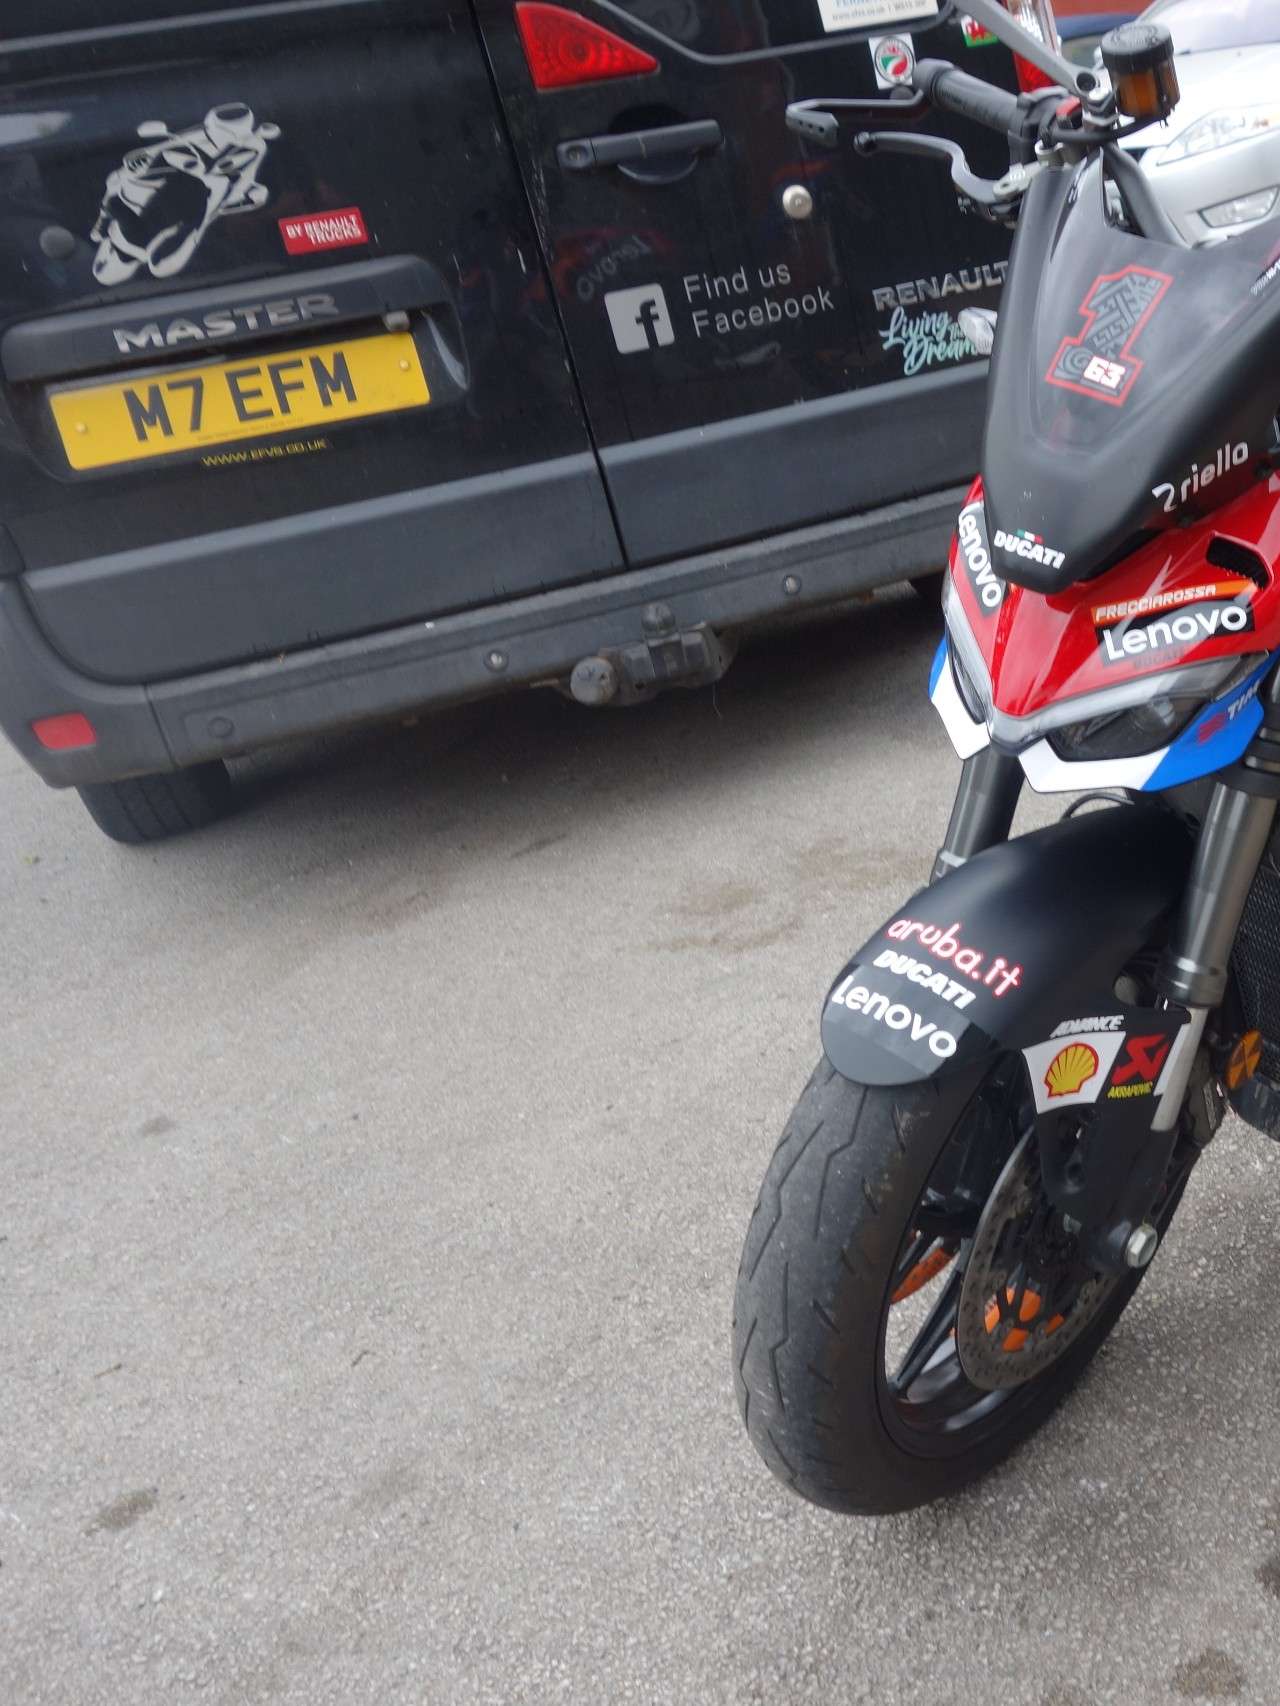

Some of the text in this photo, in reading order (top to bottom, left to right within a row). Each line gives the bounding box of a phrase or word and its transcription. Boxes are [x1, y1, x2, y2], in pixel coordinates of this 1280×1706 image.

[286, 224, 302, 240] BY
[683, 263, 791, 303] Find us
[872, 260, 1009, 312] RENAULT
[112, 293, 340, 353] MASTER
[692, 286, 835, 338] Facebook
[879, 306, 951, 350] Living
[123, 351, 358, 442] M7 EFM
[958, 500, 1002, 608] Lenovo
[993, 529, 1066, 569] DUCATI
[1103, 605, 1248, 661] Lenovo
[873, 949, 977, 1010] DUCATI
[886, 918, 1023, 998] aruba.it
[831, 975, 957, 1058] Lenovo
